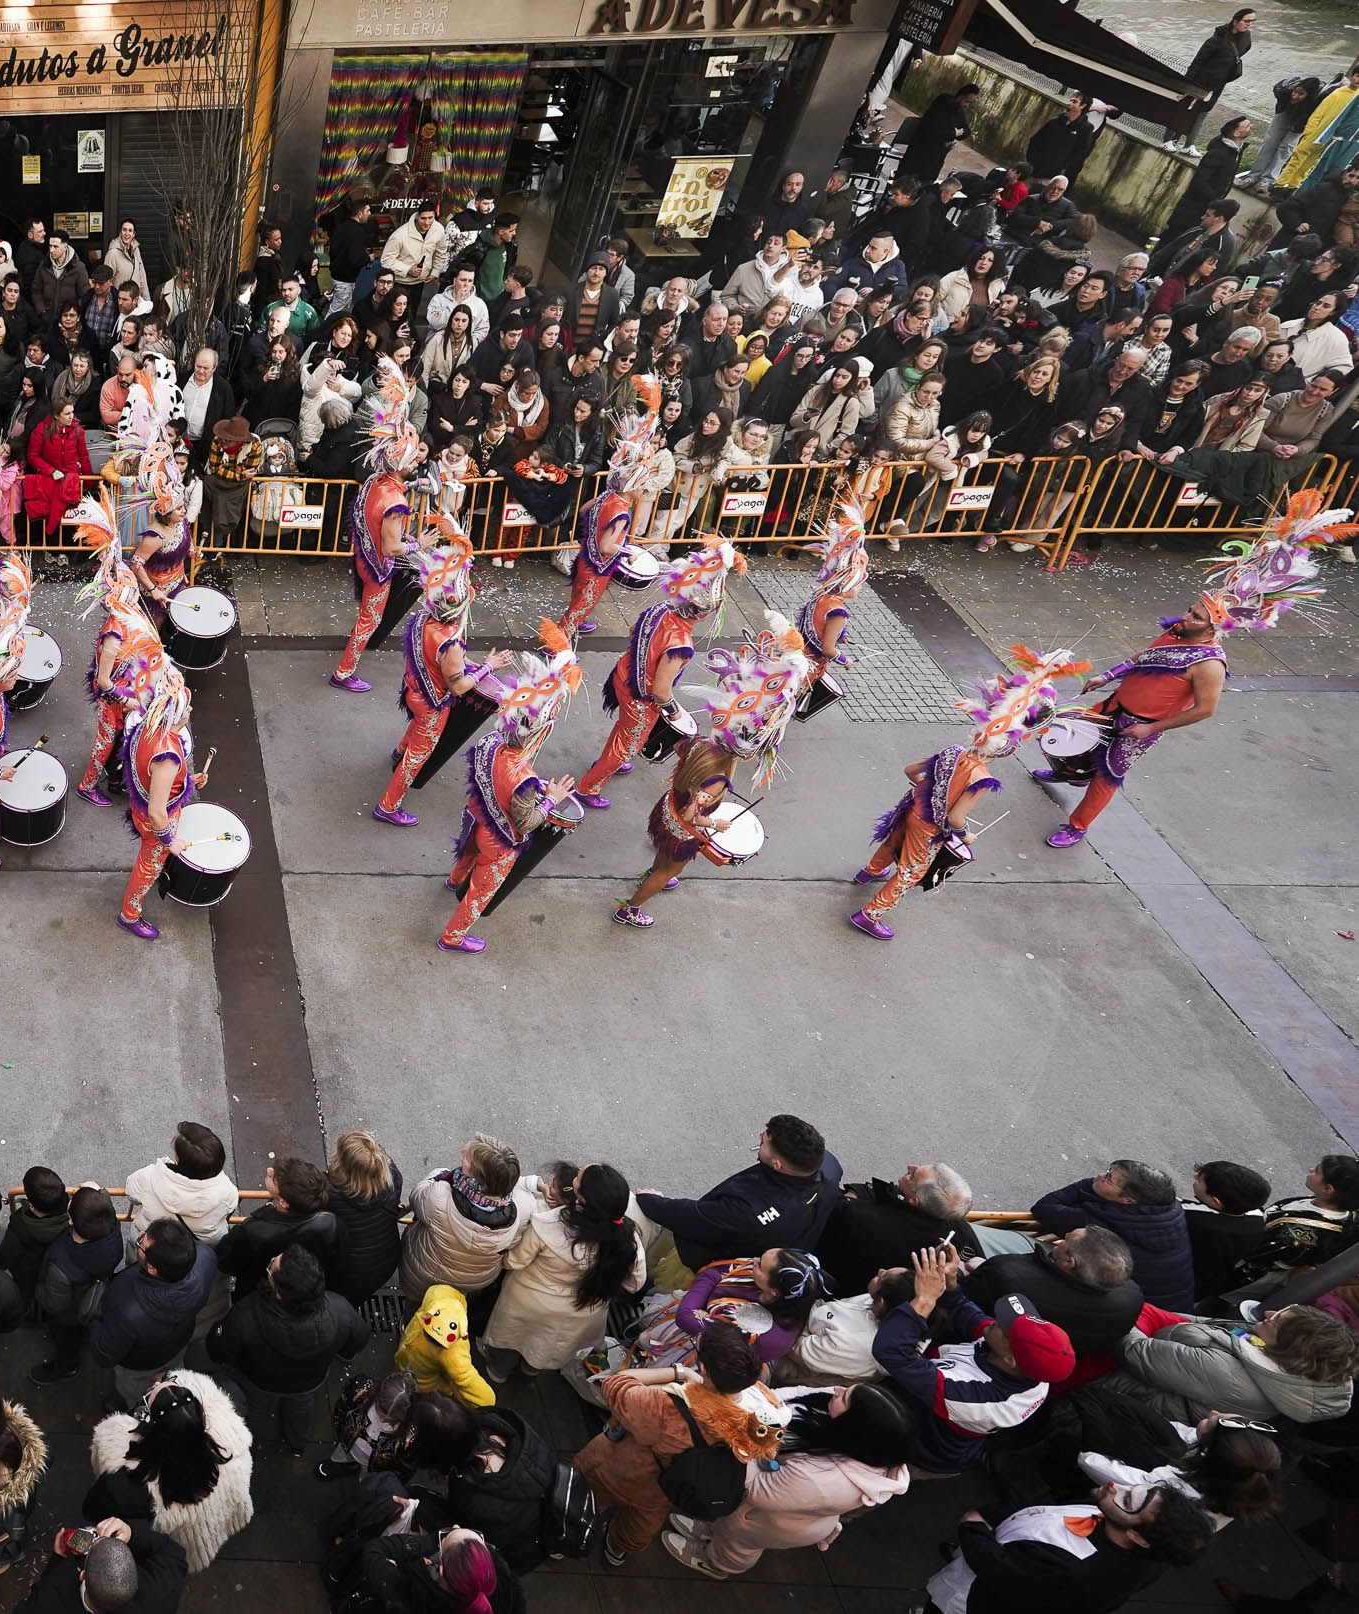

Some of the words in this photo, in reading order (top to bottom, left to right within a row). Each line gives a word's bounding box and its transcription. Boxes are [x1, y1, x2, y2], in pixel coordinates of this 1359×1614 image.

[85, 44, 107, 74] a
[113, 14, 226, 77] Granel
[666, 173, 702, 195] En
[756, 1206, 781, 1226] HH
